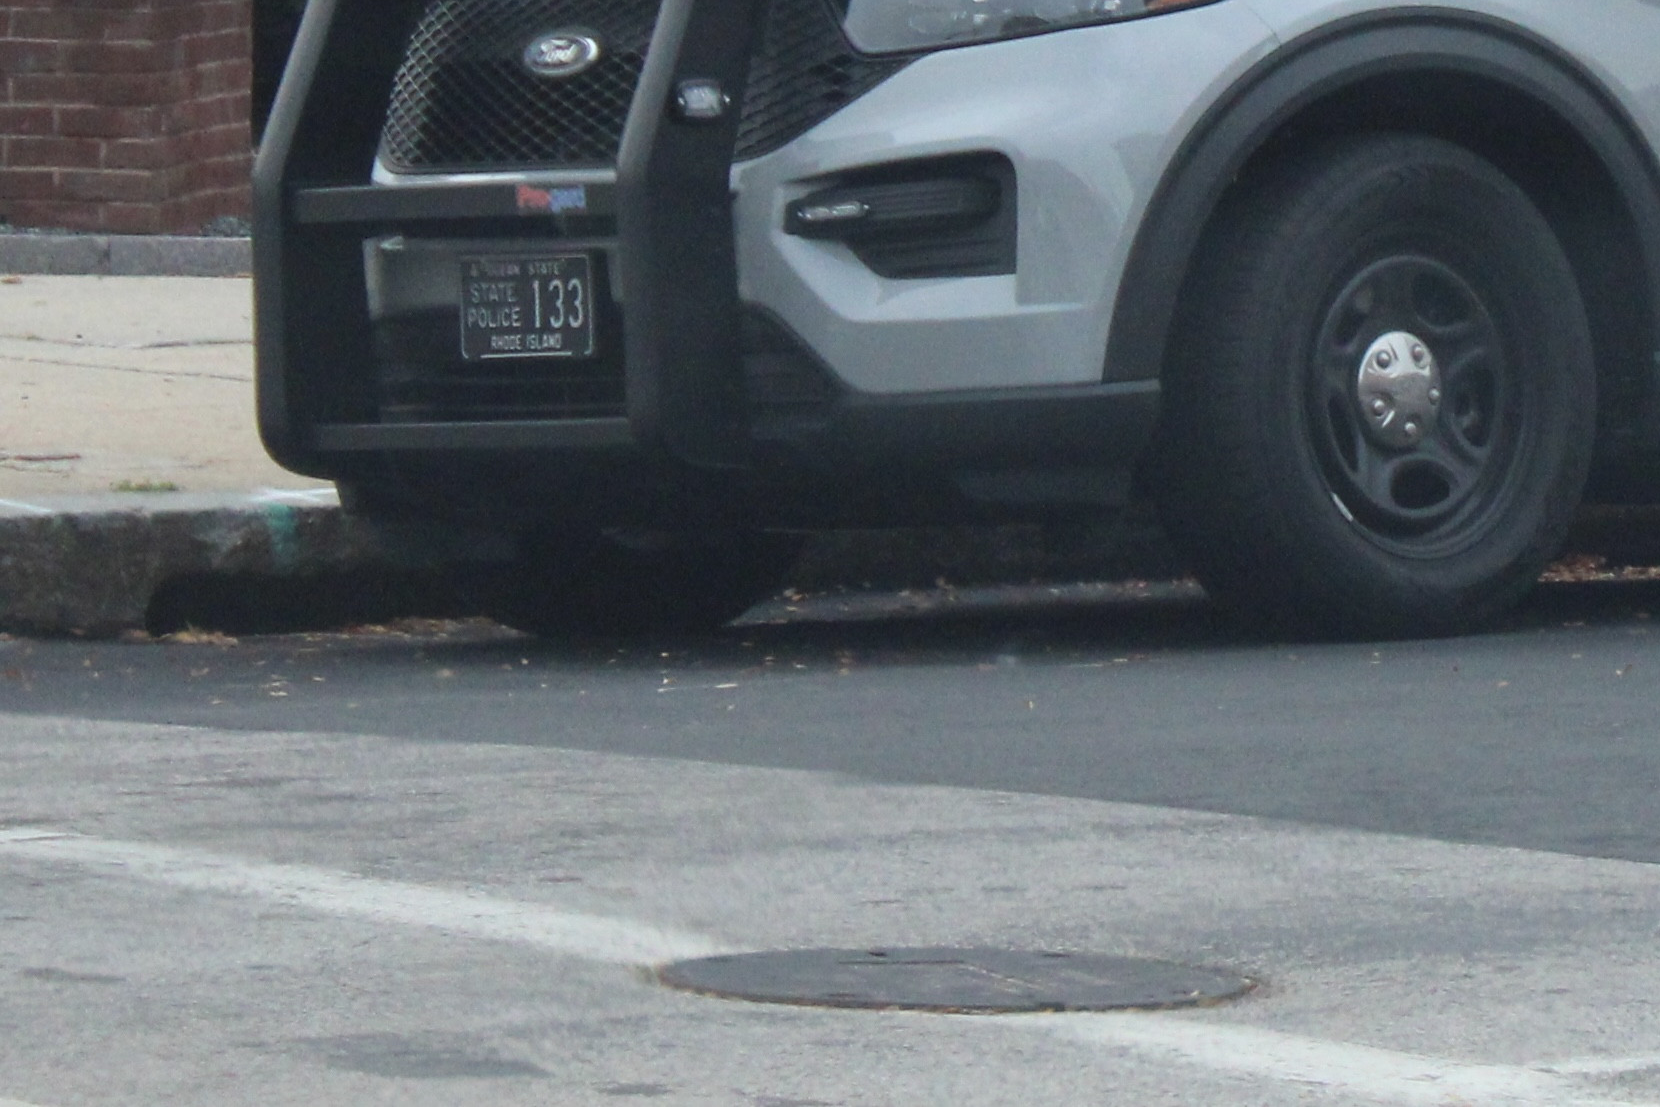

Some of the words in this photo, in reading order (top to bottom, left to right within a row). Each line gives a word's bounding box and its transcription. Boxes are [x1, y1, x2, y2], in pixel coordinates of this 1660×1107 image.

[528, 261, 560, 276] STATE
[469, 282, 517, 304] STATE
[532, 278, 584, 329] 133
[467, 307, 521, 329] POLICE
[490, 335, 521, 351] RHODE
[526, 333, 562, 350] ISLAND
